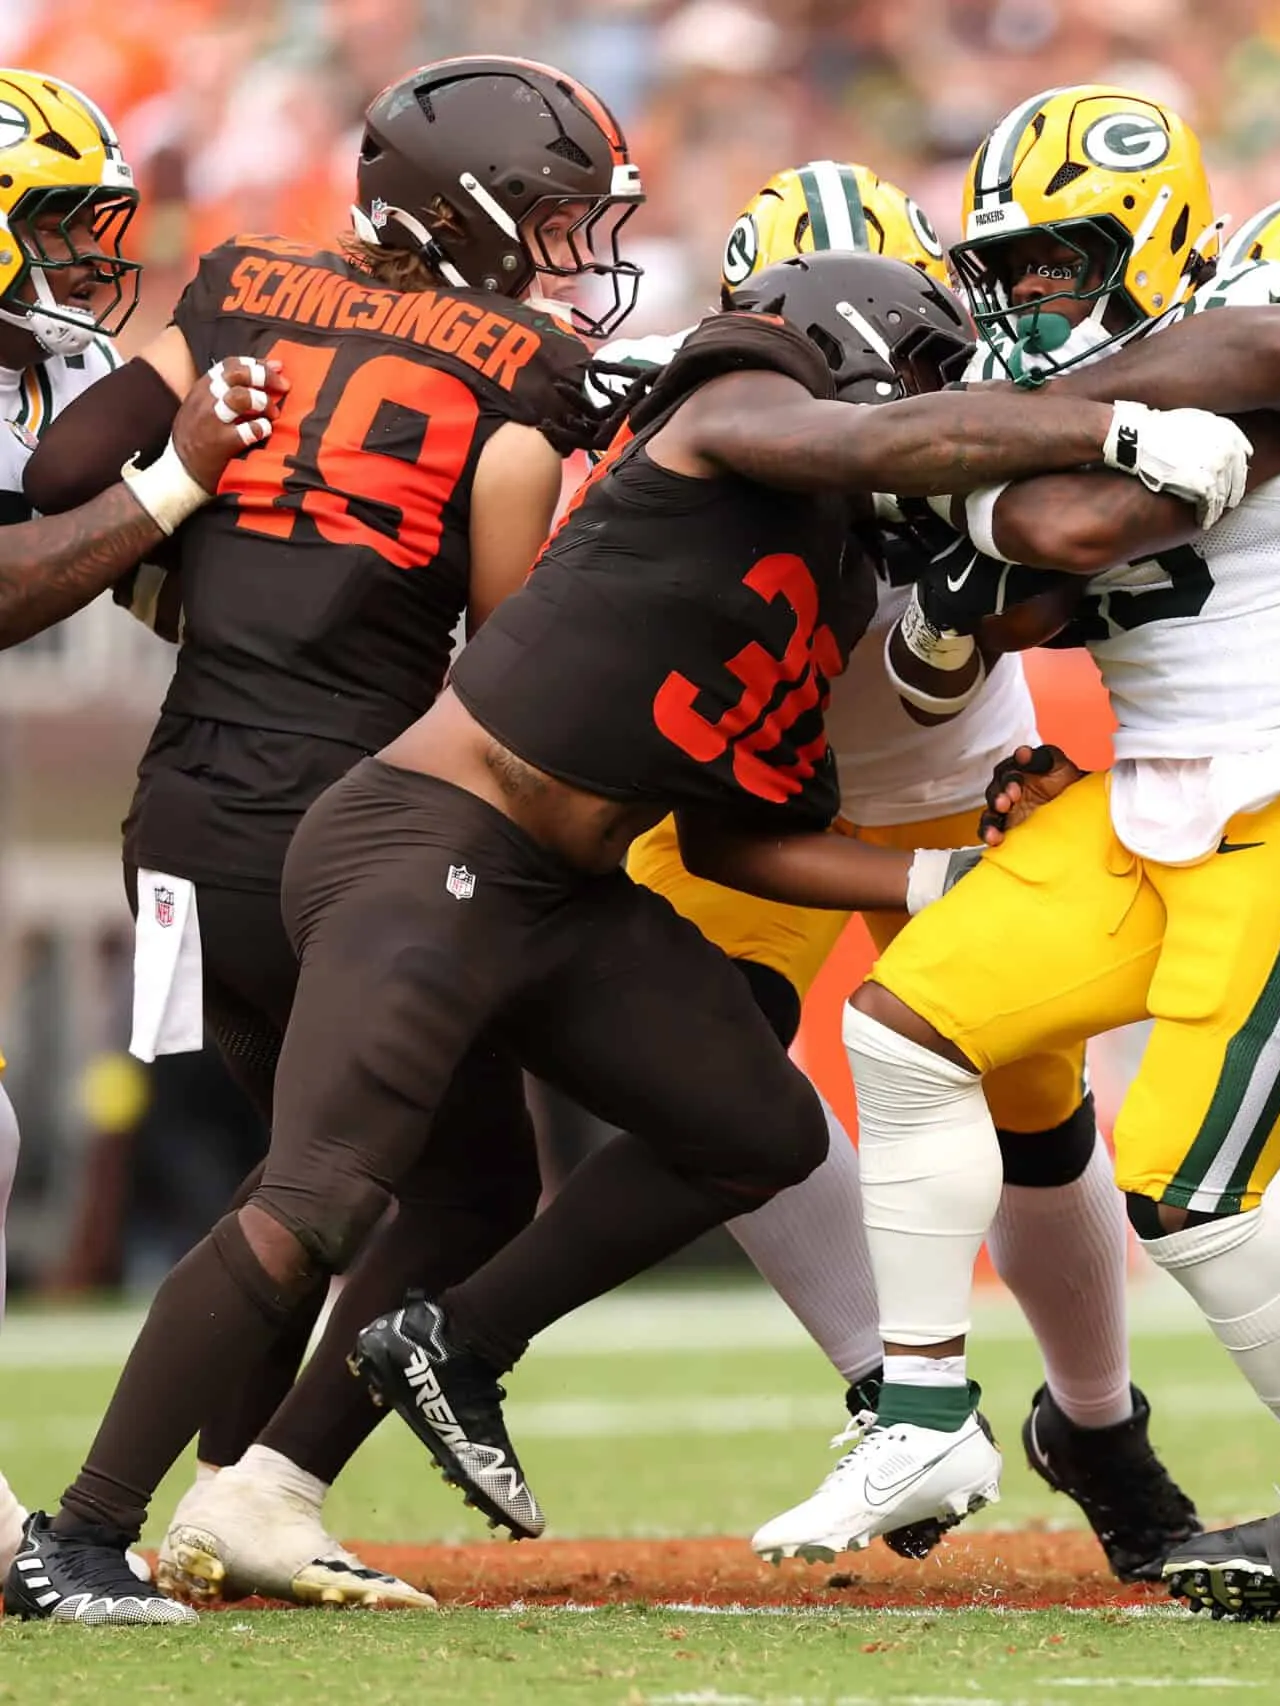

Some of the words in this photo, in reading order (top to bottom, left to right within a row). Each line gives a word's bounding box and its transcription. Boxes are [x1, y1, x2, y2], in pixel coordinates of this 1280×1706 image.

[1082, 112, 1169, 172] G
[975, 209, 1005, 228] PACKERS
[222, 256, 542, 392] SCHWESINGER
